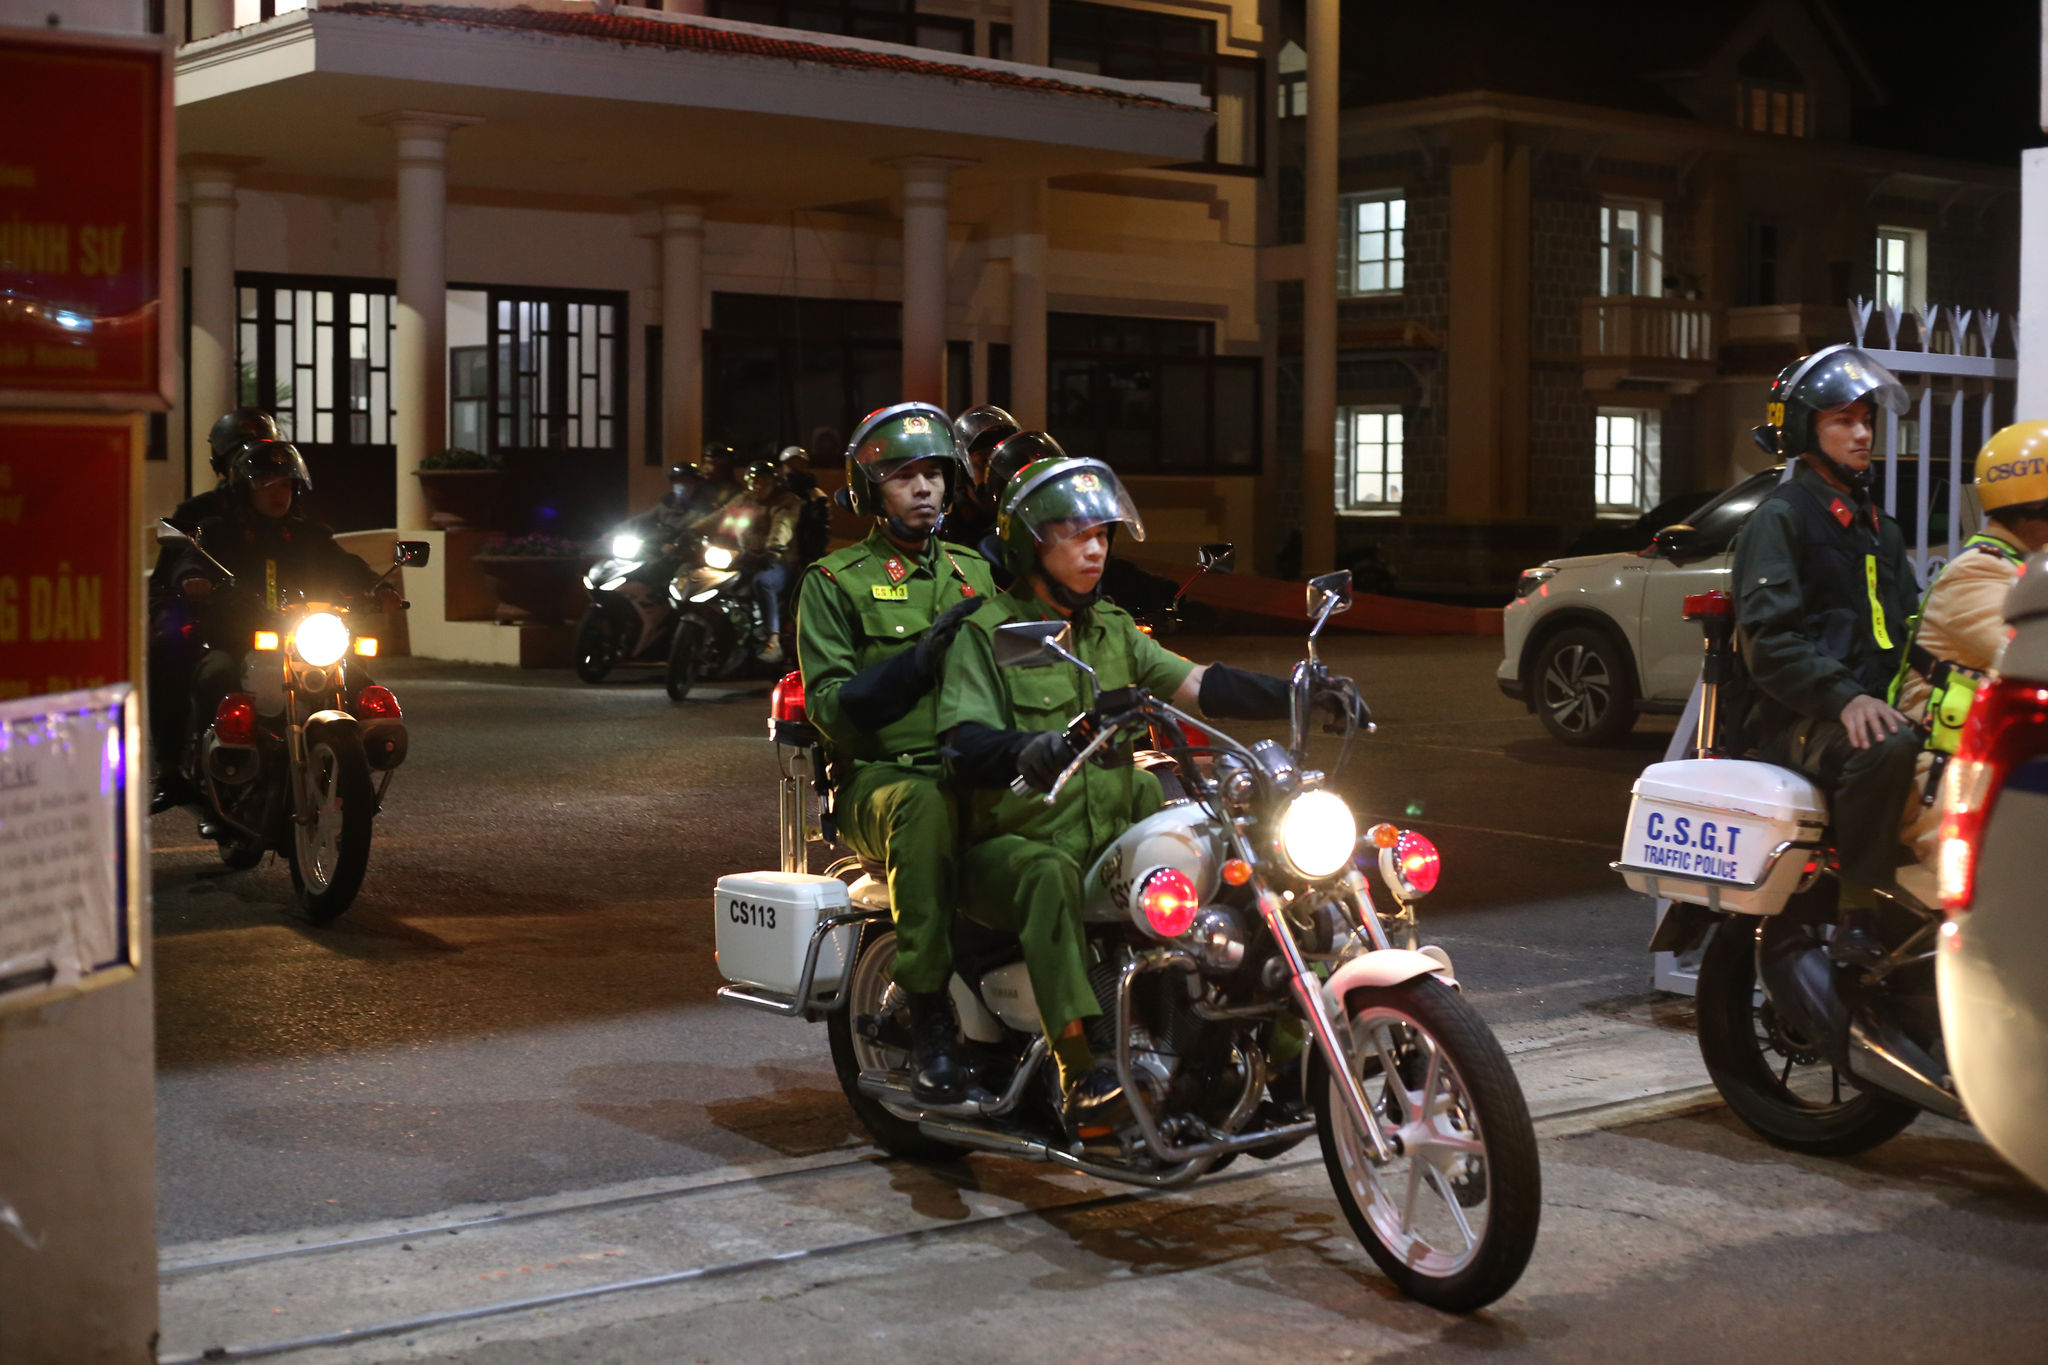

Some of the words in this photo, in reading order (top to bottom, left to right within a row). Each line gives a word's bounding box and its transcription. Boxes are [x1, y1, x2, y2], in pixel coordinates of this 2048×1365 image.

[1986, 457, 2045, 483] CSGT
[30, 561, 102, 641] DÂN
[1647, 812, 1741, 855] C.S.G.T
[1644, 844, 1691, 871] TRAFFIC
[1694, 854, 1738, 880] POLICE
[729, 899, 777, 930] CS113
